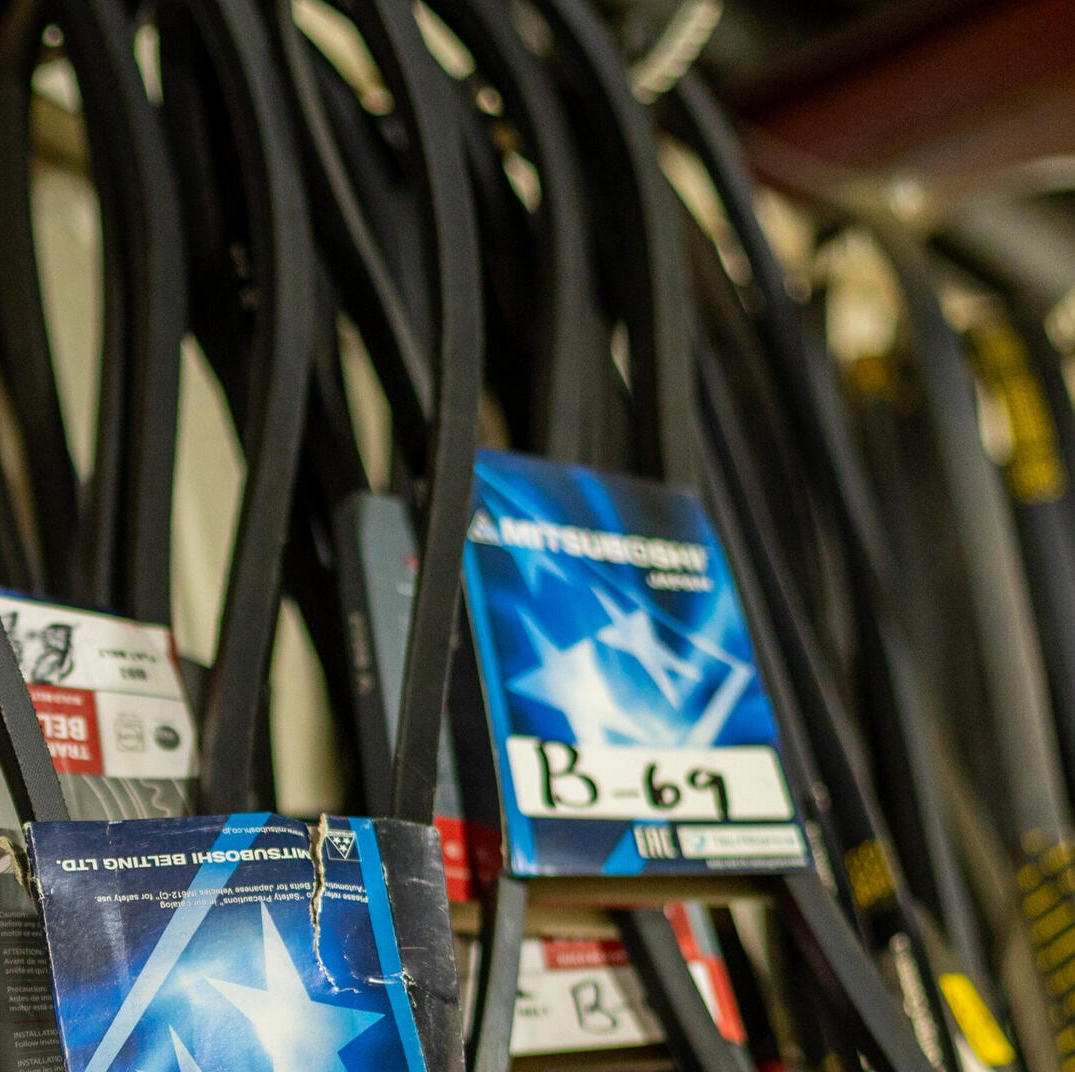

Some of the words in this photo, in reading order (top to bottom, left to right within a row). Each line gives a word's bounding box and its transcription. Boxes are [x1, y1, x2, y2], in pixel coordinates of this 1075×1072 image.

[499, 516, 709, 573] MITSUBOSHI
[38, 713, 86, 742] BEL
[192, 847, 312, 865] MITSUBOSHI
[56, 858, 98, 872] LTD.
[103, 853, 186, 870] BELTING
[199, 886, 233, 895] Vehicles
[234, 884, 274, 893] Japanese
[276, 883, 288, 891] for
[289, 882, 311, 890] Belts
[323, 881, 367, 893] "Automotiv
[93, 895, 112, 903] use.
[114, 893, 139, 903] safety
[141, 893, 153, 901] for
[342, 893, 369, 903] Please
[159, 899, 191, 909] catalog
[13, 1028, 59, 1039] INSTALLATIO
[14, 1040, 39, 1048] Follow
[17, 1055, 63, 1067] INSTALLATIO
